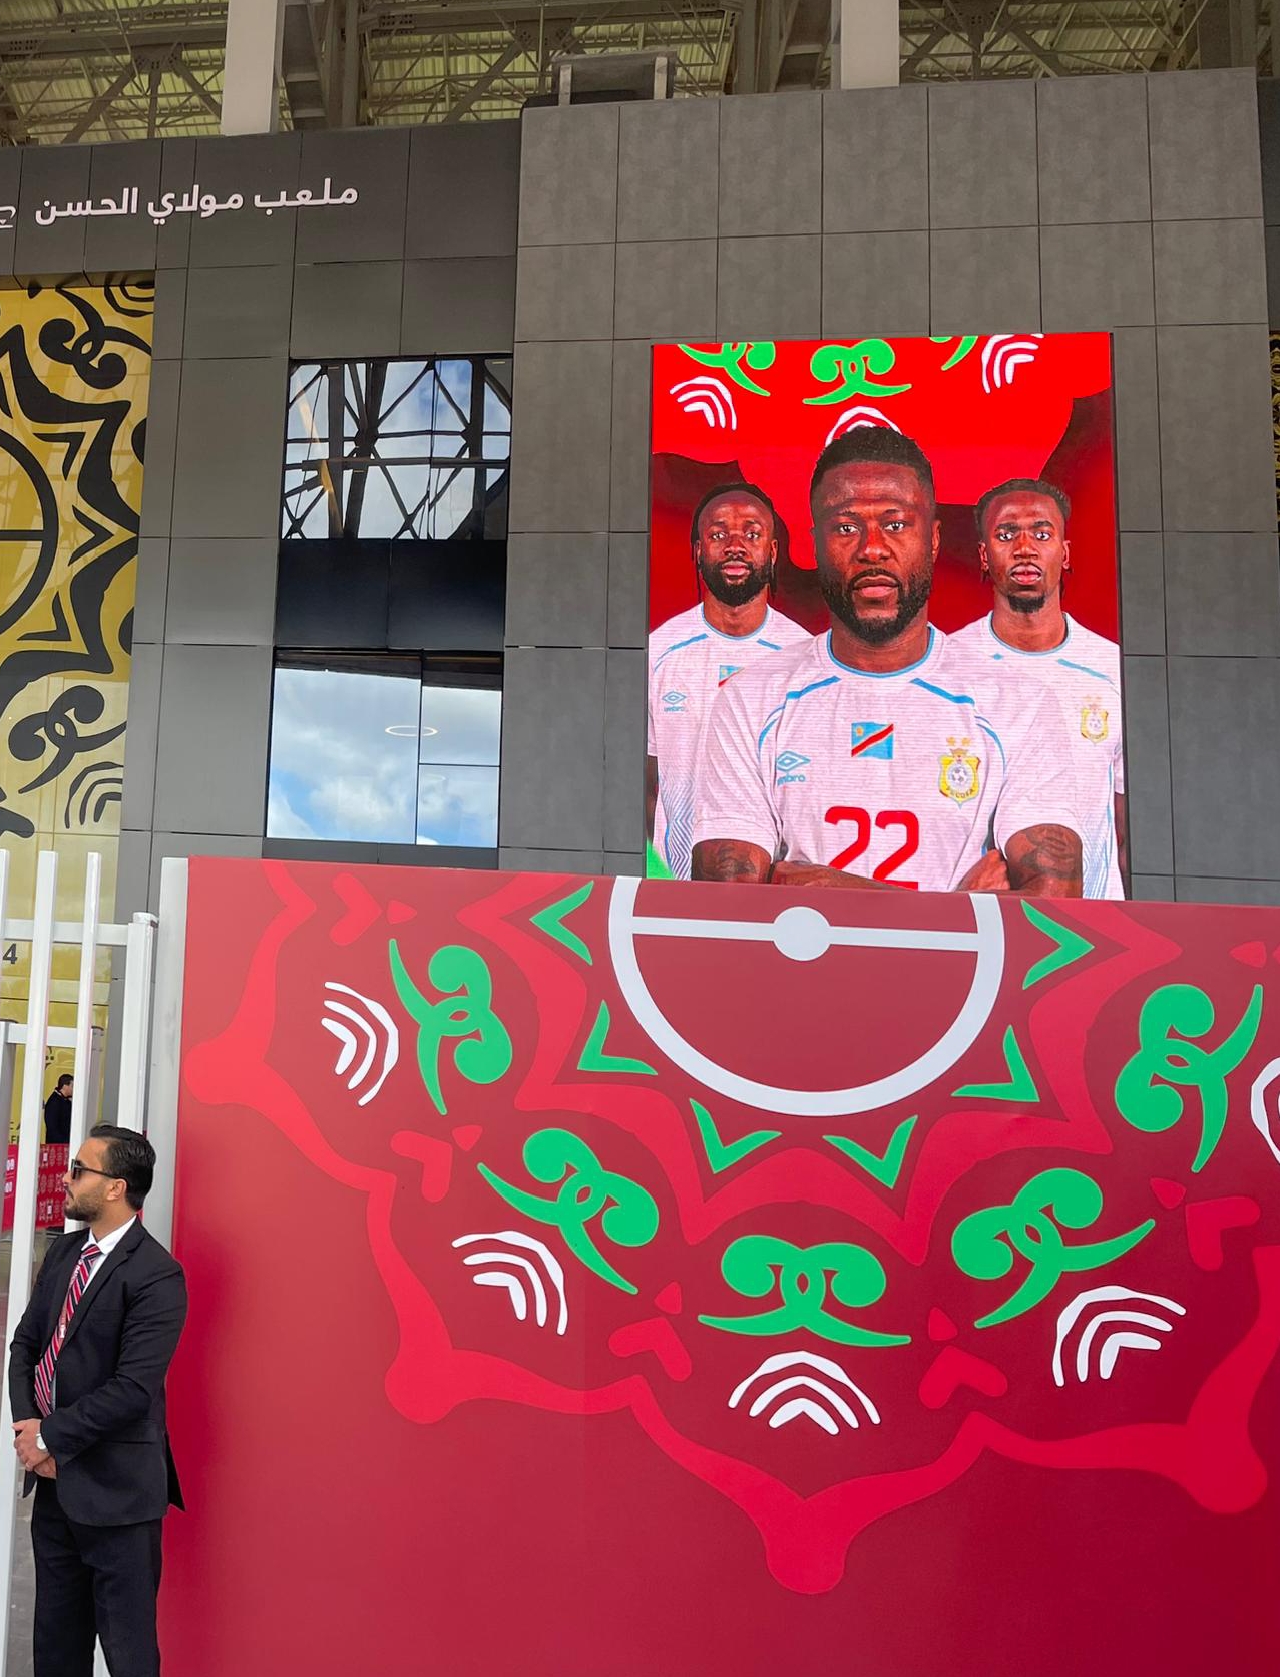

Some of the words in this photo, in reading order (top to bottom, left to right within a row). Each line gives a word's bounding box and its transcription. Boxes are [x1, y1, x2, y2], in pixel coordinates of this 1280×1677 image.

[35, 187, 139, 225] الحسن
[147, 184, 244, 226] مولاي
[254, 178, 359, 216] ملعب
[777, 773, 806, 786] mbro
[824, 806, 919, 890] 22
